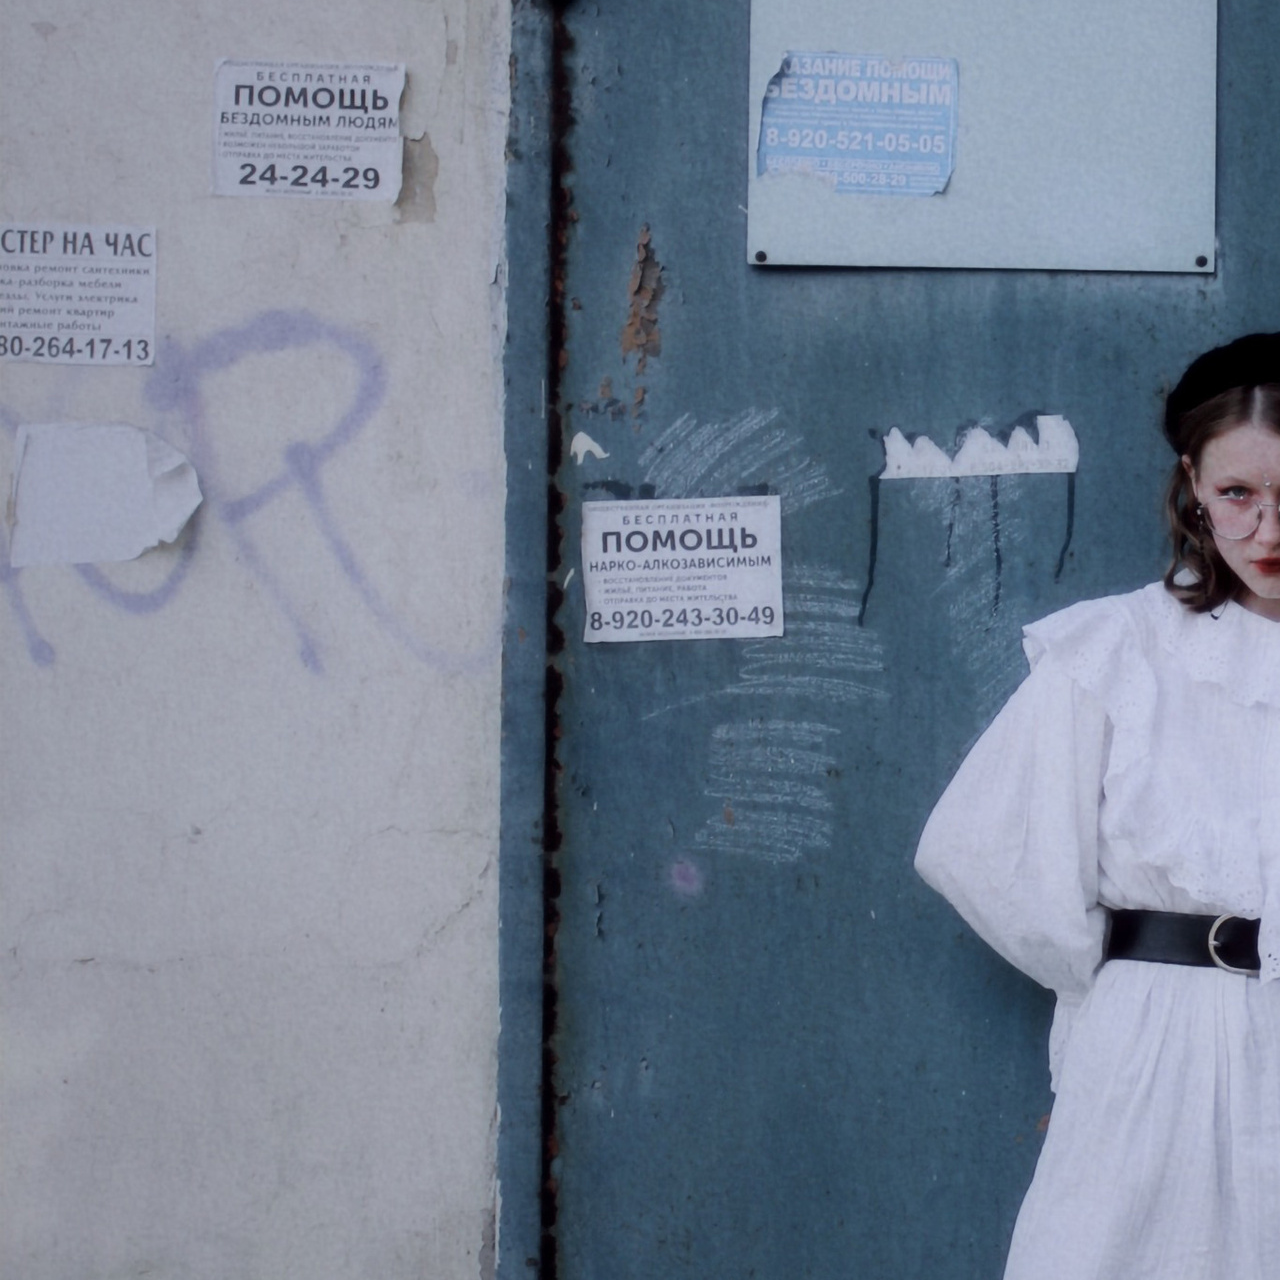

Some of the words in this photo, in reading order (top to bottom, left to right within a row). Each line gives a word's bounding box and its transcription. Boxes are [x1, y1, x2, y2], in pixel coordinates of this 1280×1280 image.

[257, 71, 371, 85] БЕСПЛАТНАЯ
[234, 84, 389, 114] ПОМОЩЬ
[220, 112, 331, 128] БЕЗДОМНЫМ
[336, 116, 397, 130] ЛЮДЯМ
[766, 126, 945, 154] 8-920-521-05-05
[239, 163, 380, 190] 24-24-29
[1, 229, 54, 254] СТЕР
[62, 231, 95, 255] НА
[105, 232, 152, 257] ЧАС
[0, 263, 30, 273] овка
[34, 264, 78, 274] ремонт
[82, 265, 150, 276] сантехники
[78, 278, 122, 289] мебели
[36, 291, 72, 304] Услуги
[78, 294, 138, 305] электрика
[18, 306, 63, 318] ремонт
[66, 308, 115, 319] квартир
[57, 319, 101, 332] работы
[622, 511, 738, 526] БЕСПЛАТНАЯ
[602, 527, 758, 553] ПОМОЩЬ
[589, 555, 771, 572] НАРКО-АЛКОЗАВИСИМЫМ
[604, 596, 644, 605] ОТПРАВКА
[645, 596, 657, 604] ДО
[659, 595, 684, 603] МЕСТА
[590, 606, 775, 631] 8-920-243-30-49
